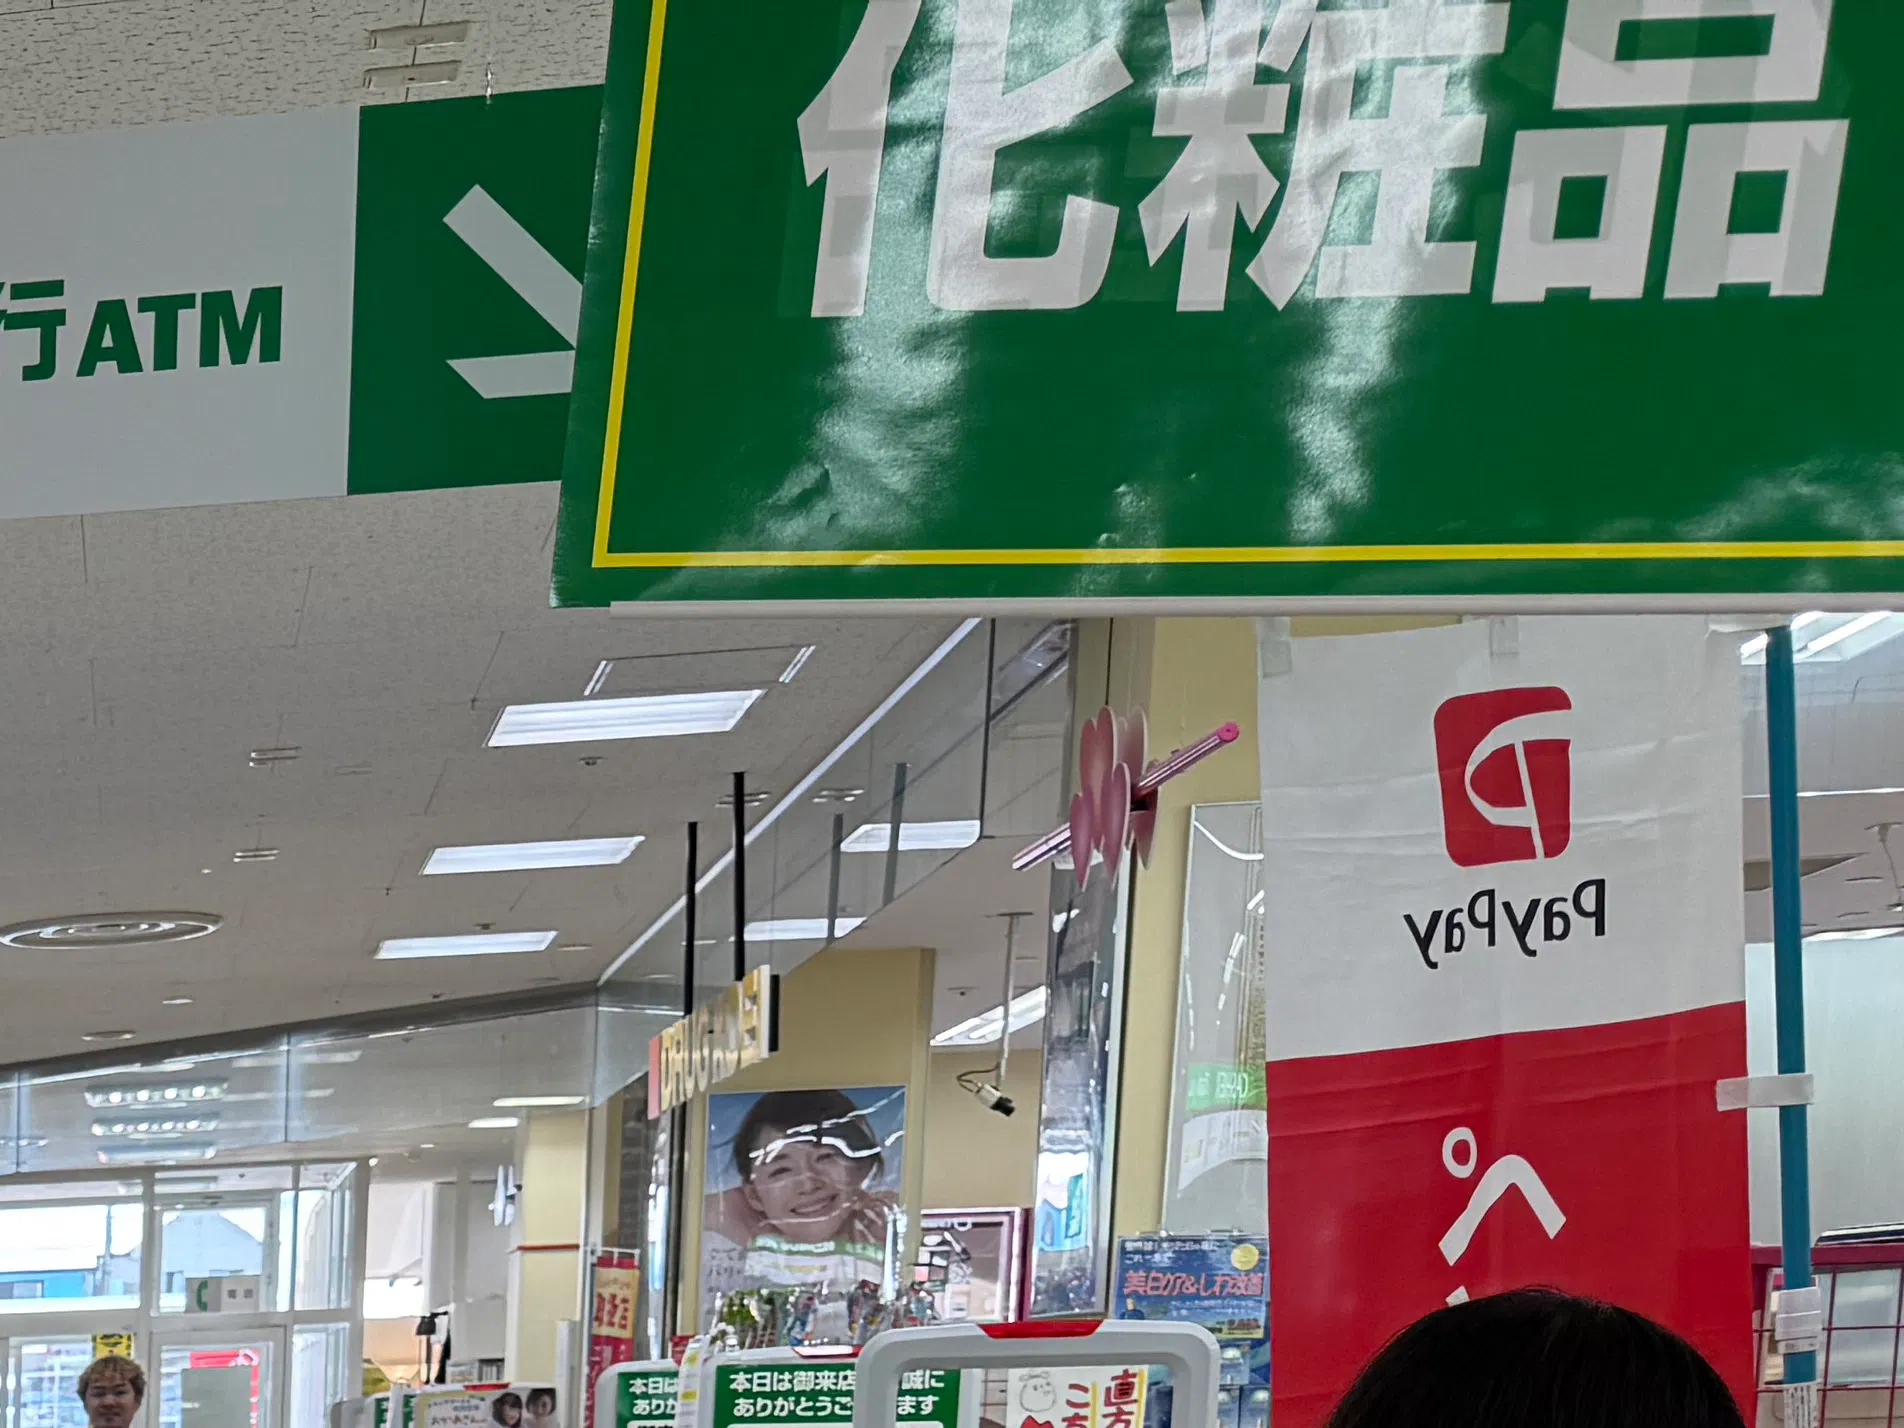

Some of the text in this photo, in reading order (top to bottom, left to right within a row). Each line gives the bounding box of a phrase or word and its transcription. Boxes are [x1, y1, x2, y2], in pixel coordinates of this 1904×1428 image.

[796, 0, 1850, 318] 化粧品
[733, 1395, 940, 1417] ありがとうごます
